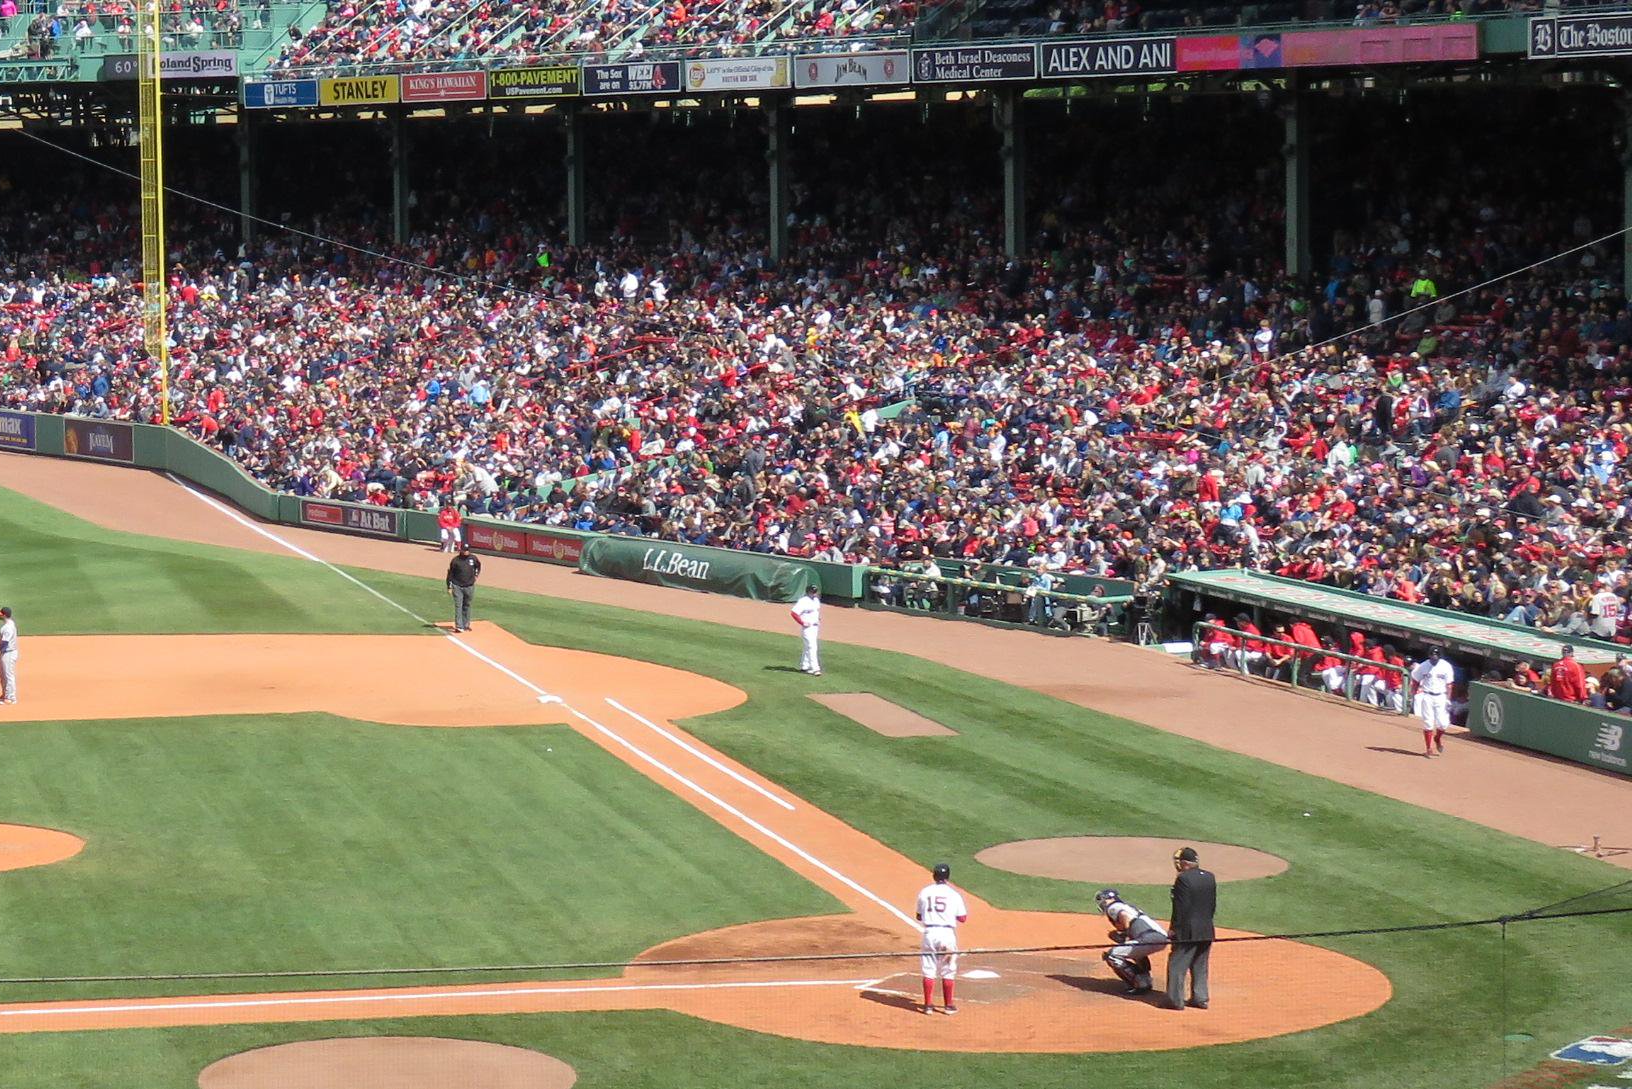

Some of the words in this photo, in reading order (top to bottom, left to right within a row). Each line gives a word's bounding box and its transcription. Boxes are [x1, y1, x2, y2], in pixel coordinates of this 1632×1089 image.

[1559, 23, 1585, 49] The
[192, 56, 233, 72] Spring
[935, 52, 955, 65] Beth
[957, 50, 982, 64] Israel
[984, 50, 1031, 63] Deaconess
[1048, 47, 1090, 72] ALEX
[1094, 45, 1135, 71] AND
[1139, 43, 1171, 69] ANI
[491, 69, 577, 87] 1-800-PAVEMENT
[596, 70, 608, 79] The
[609, 69, 622, 79] Sox
[628, 65, 653, 80] WEEI
[935, 66, 970, 79] Medical
[973, 65, 1003, 78] Center
[274, 83, 297, 95] TUFTS
[333, 80, 387, 100] STANLEY
[409, 78, 435, 90] KING'S
[436, 75, 477, 87] HAWAIIAN
[599, 81, 610, 90] are
[611, 81, 620, 89] on
[360, 510, 372, 528] At
[372, 512, 390, 532] Bat
[472, 531, 492, 546] Ninety
[1601, 606, 1617, 618] 15
[927, 895, 946, 913] 15
